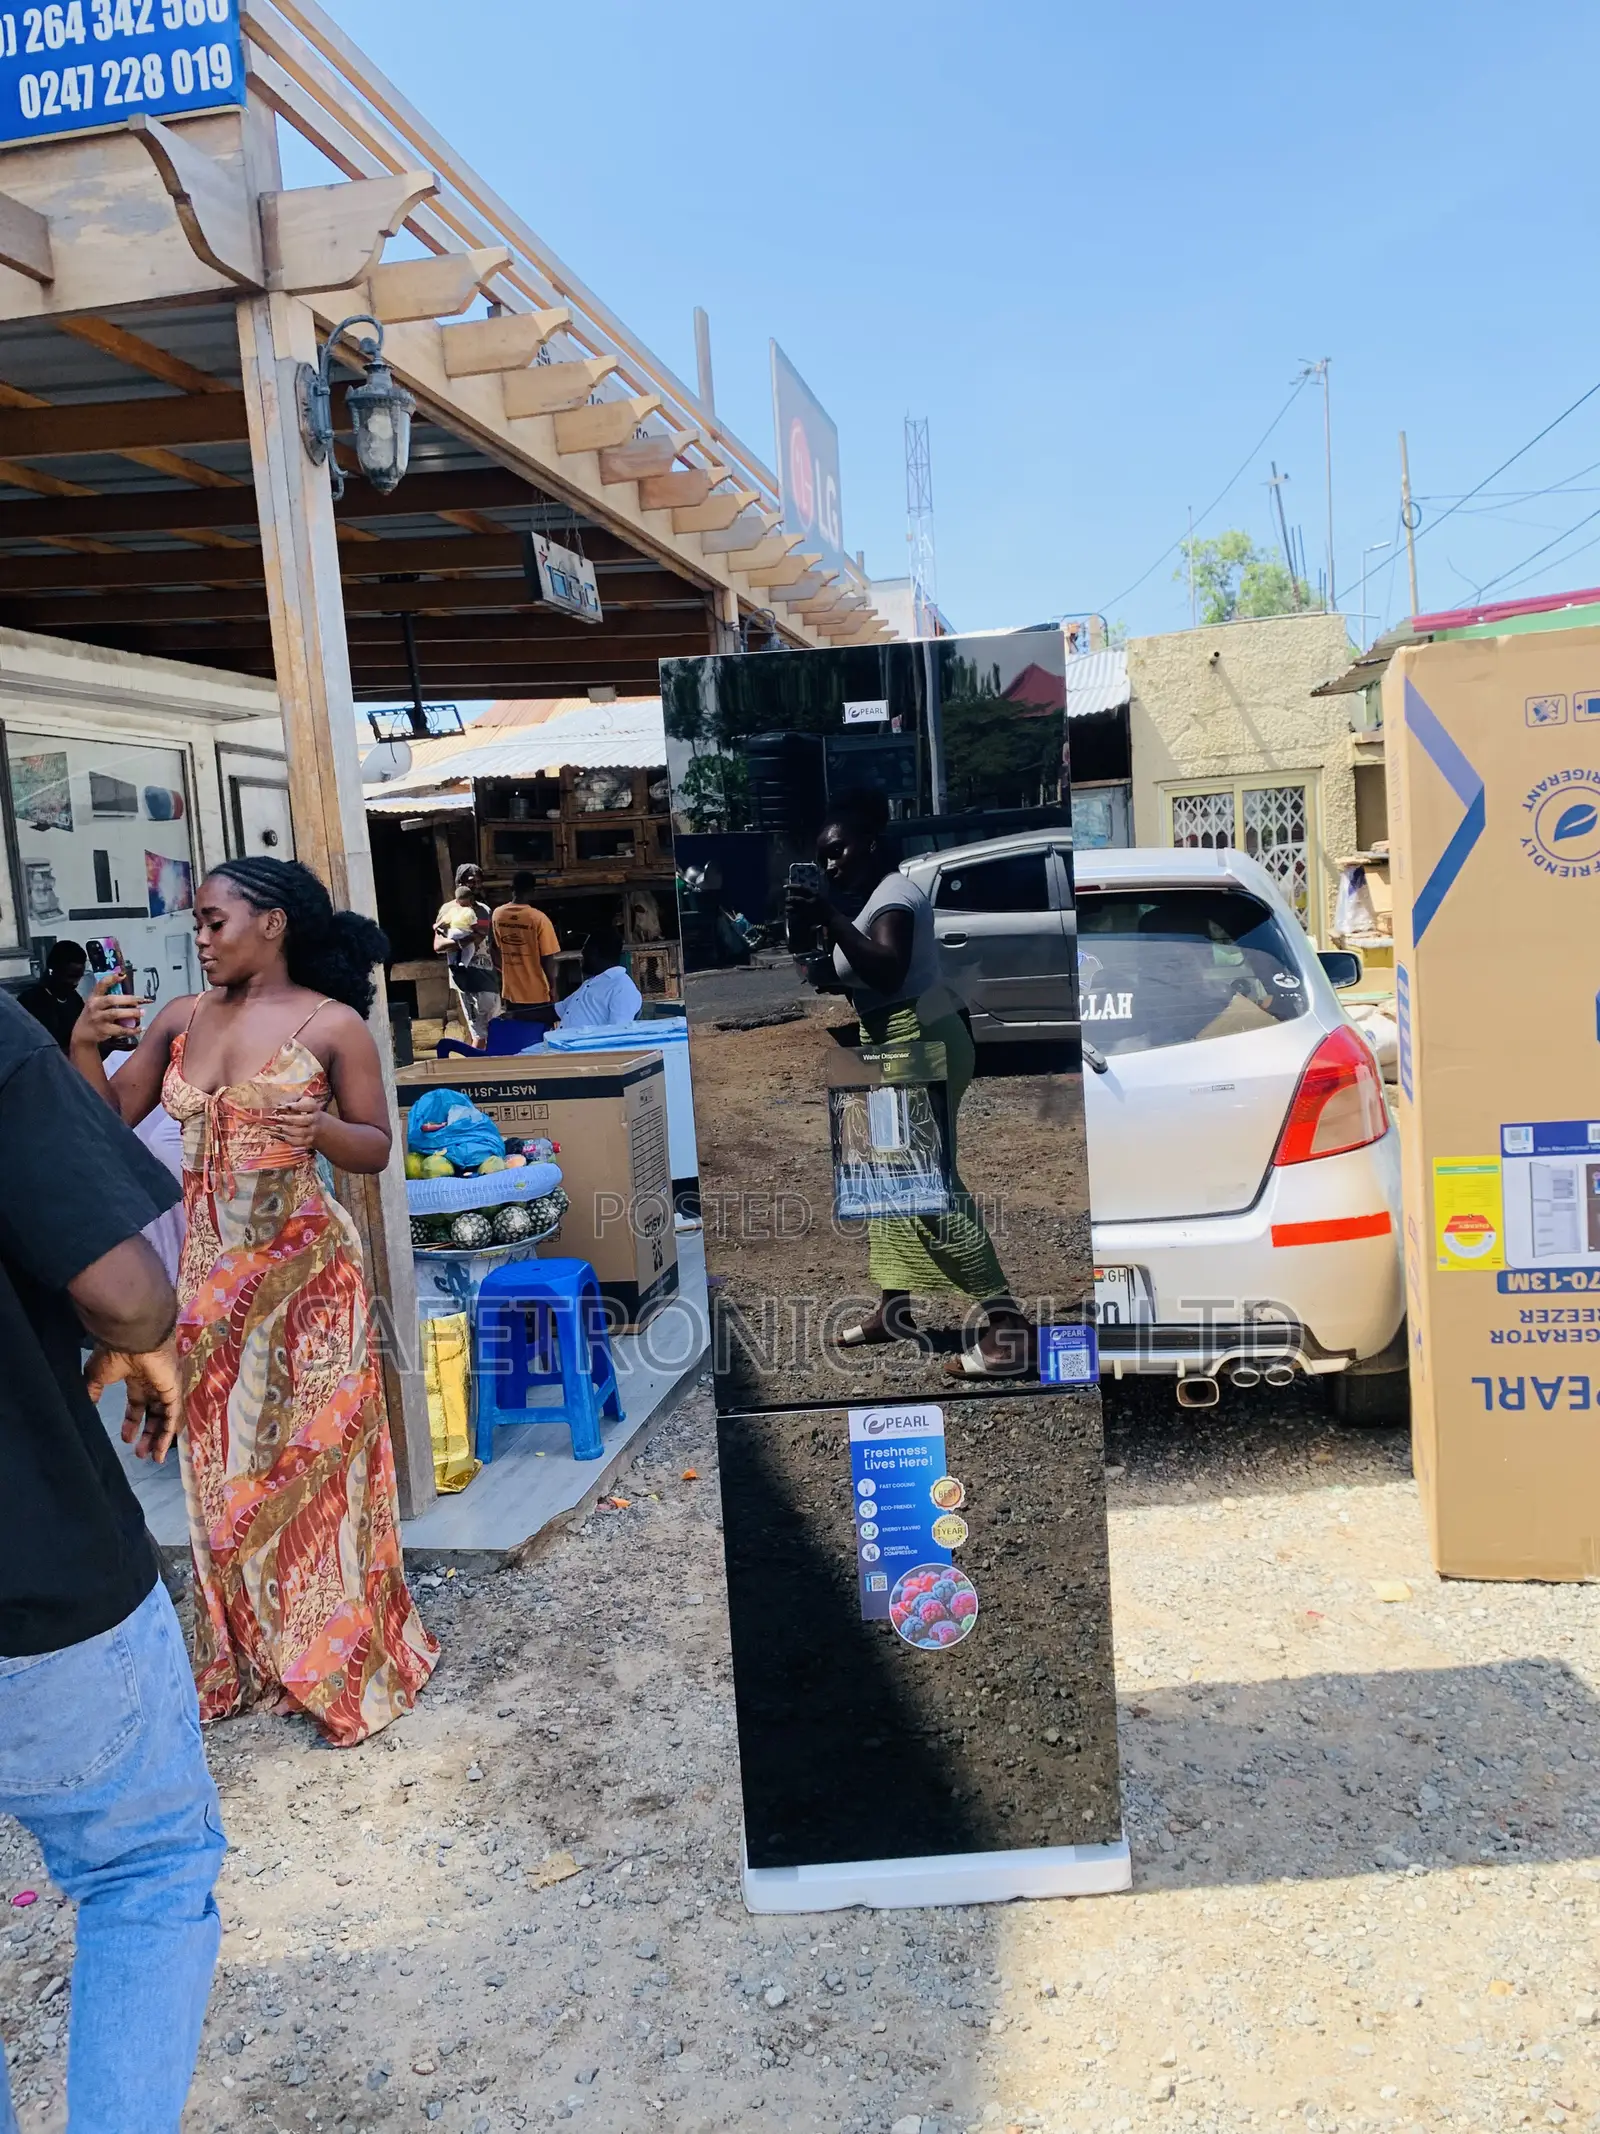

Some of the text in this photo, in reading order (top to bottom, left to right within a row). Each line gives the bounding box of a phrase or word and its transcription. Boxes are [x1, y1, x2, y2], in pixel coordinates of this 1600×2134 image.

[23, 1, 86, 54] 264
[91, 0, 155, 42] 342
[19, 43, 233, 119] 0247 228 019
[815, 457, 839, 552] LG
[860, 707, 884, 716] PEARL
[862, 1052, 910, 1061] Water Dispenser
[1107, 1269, 1127, 1283] GH
[1062, 1329, 1087, 1338] PEARL
[1471, 1375, 1600, 1411] EARL
[885, 1415, 930, 1429] PEARL
[863, 1446, 928, 1459] Freshness
[864, 1455, 933, 1471] Lives Here!
[938, 1487, 957, 1499] BEST
[880, 1503, 917, 1511] ECO-FRIENDLY
[942, 1527, 963, 1535] YEAR
